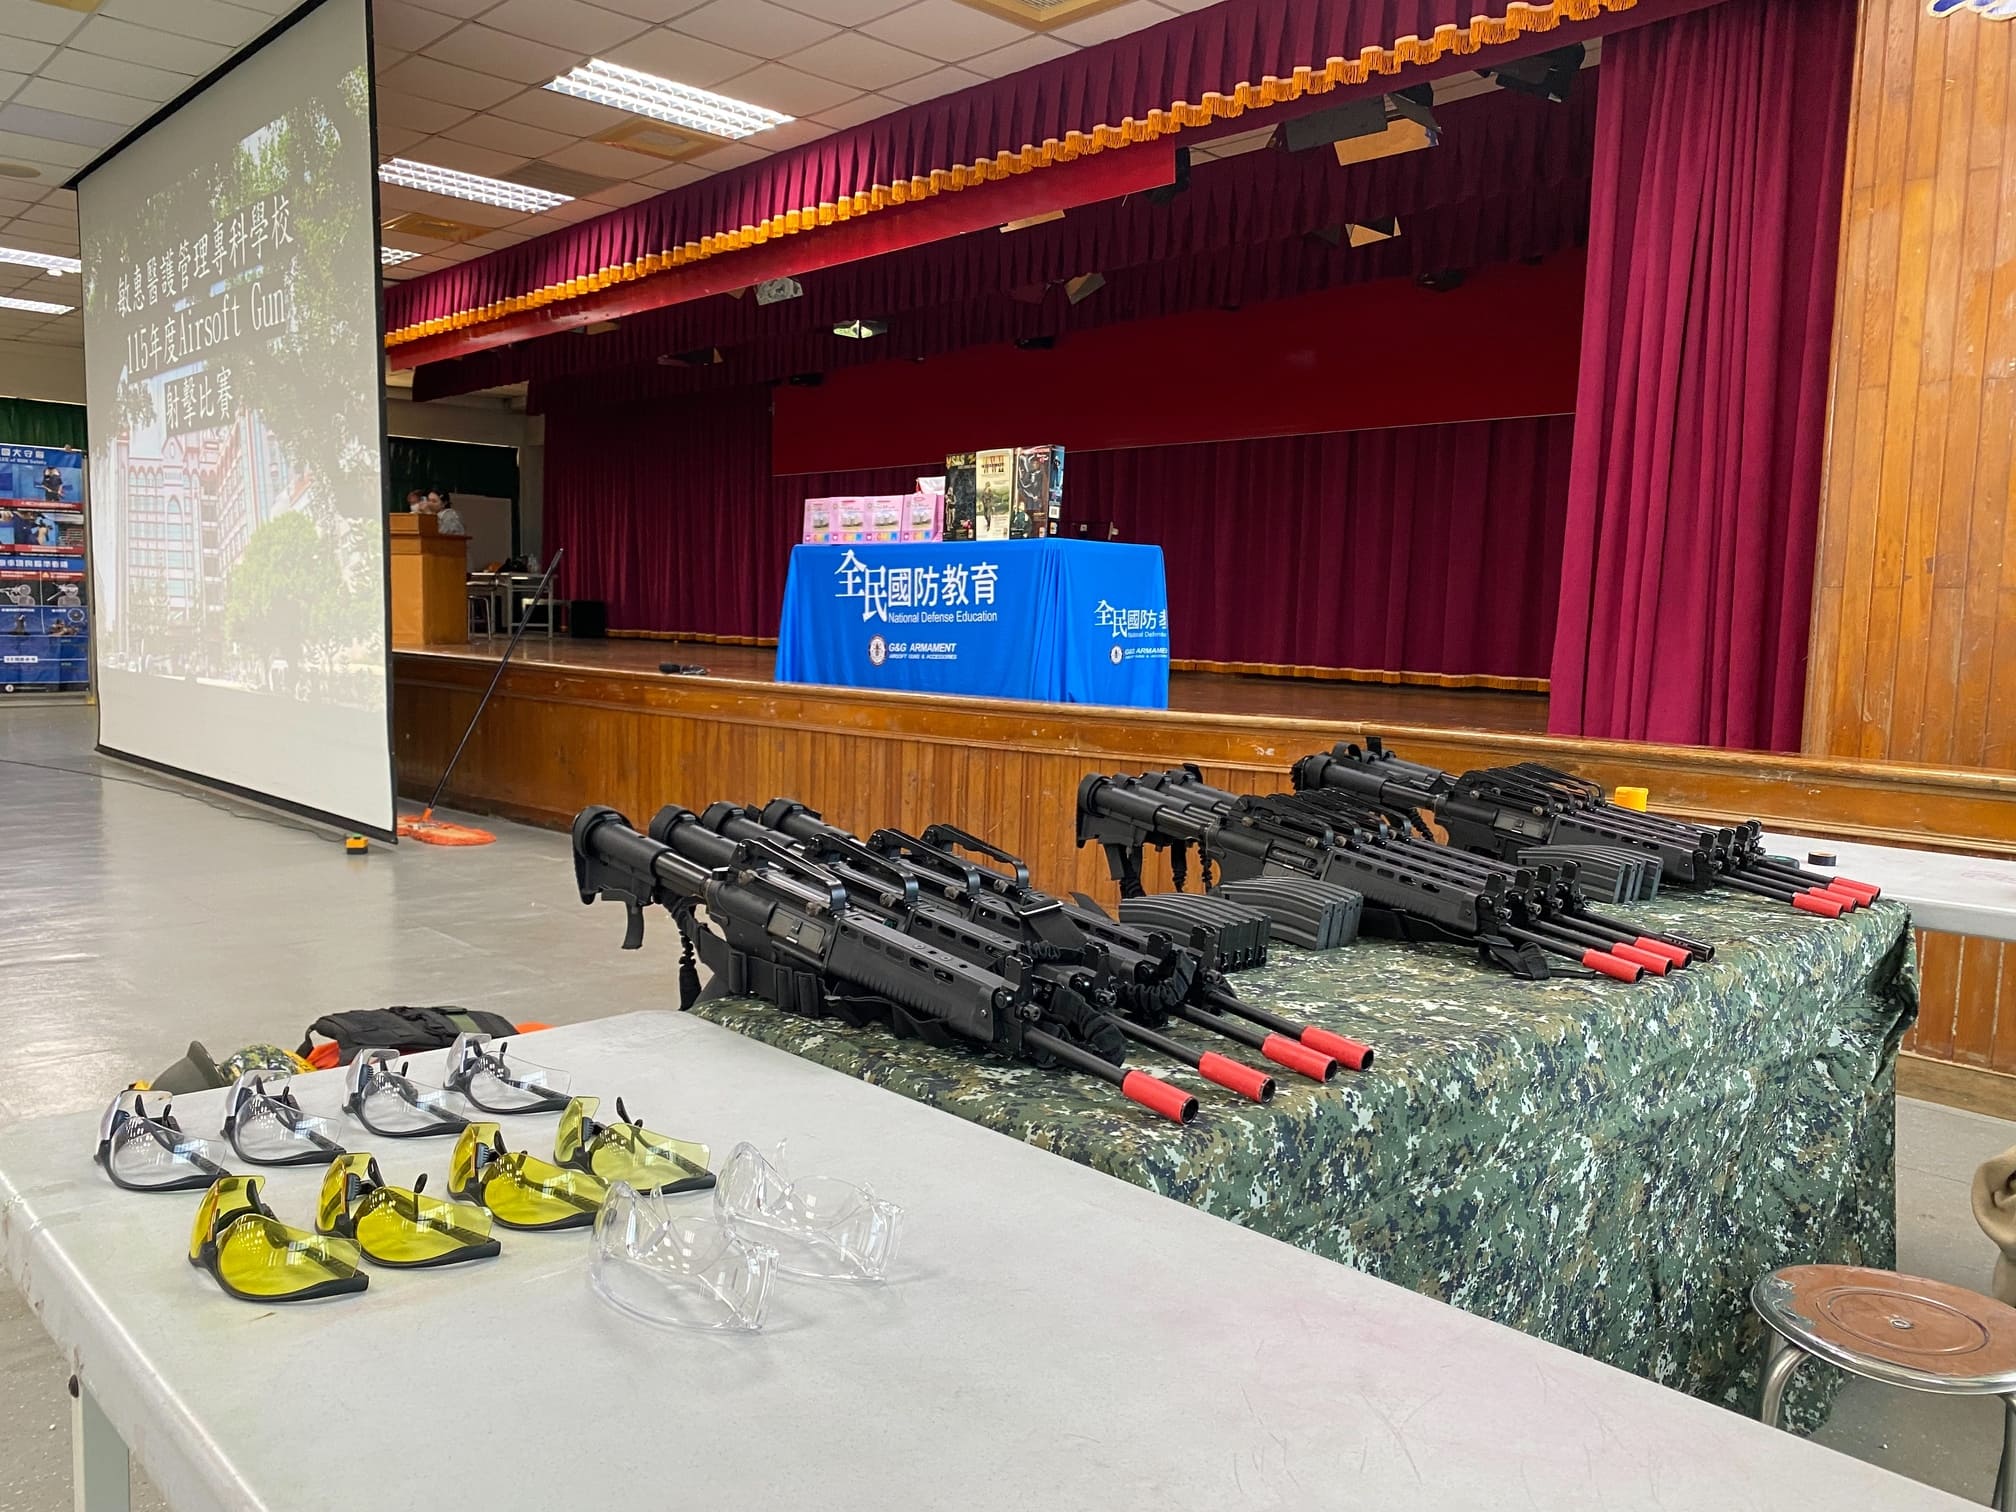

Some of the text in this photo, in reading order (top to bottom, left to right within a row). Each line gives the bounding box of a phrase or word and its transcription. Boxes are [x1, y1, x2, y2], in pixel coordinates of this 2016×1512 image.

[117, 195, 294, 318] 敏惠醫護管理專科學校
[126, 281, 286, 375] 115年度Airsoft Gun
[165, 366, 233, 430] 射擊比賽
[834, 549, 999, 623] 全民國防教育
[888, 610, 998, 623] National Defense Education
[888, 642, 957, 652] G&G ARMAMENT
